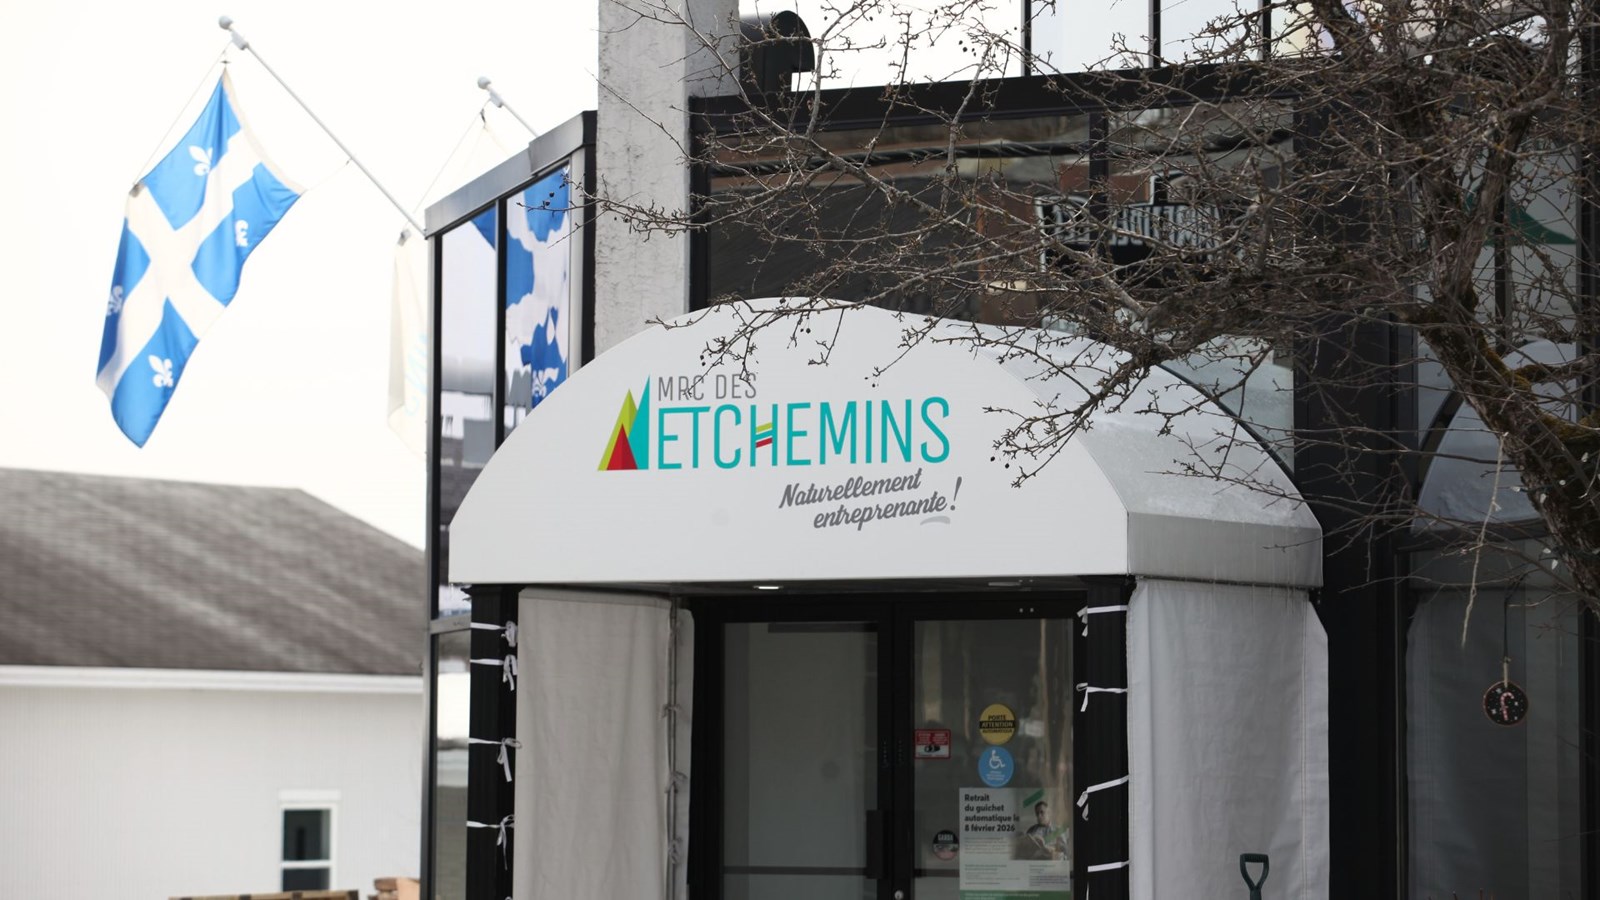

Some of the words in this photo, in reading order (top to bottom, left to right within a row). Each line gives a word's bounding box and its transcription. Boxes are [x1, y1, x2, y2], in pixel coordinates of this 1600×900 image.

[657, 375, 705, 401] MRC
[715, 372, 757, 399] DES
[657, 396, 950, 470] ETCHEMINS
[779, 467, 922, 508] Naturellement
[964, 794, 990, 802] Retrait
[964, 804, 974, 812] du
[976, 804, 1004, 813] guichet
[964, 814, 1011, 823] automatique
[970, 824, 995, 832] février
[997, 824, 1016, 832] 2026
